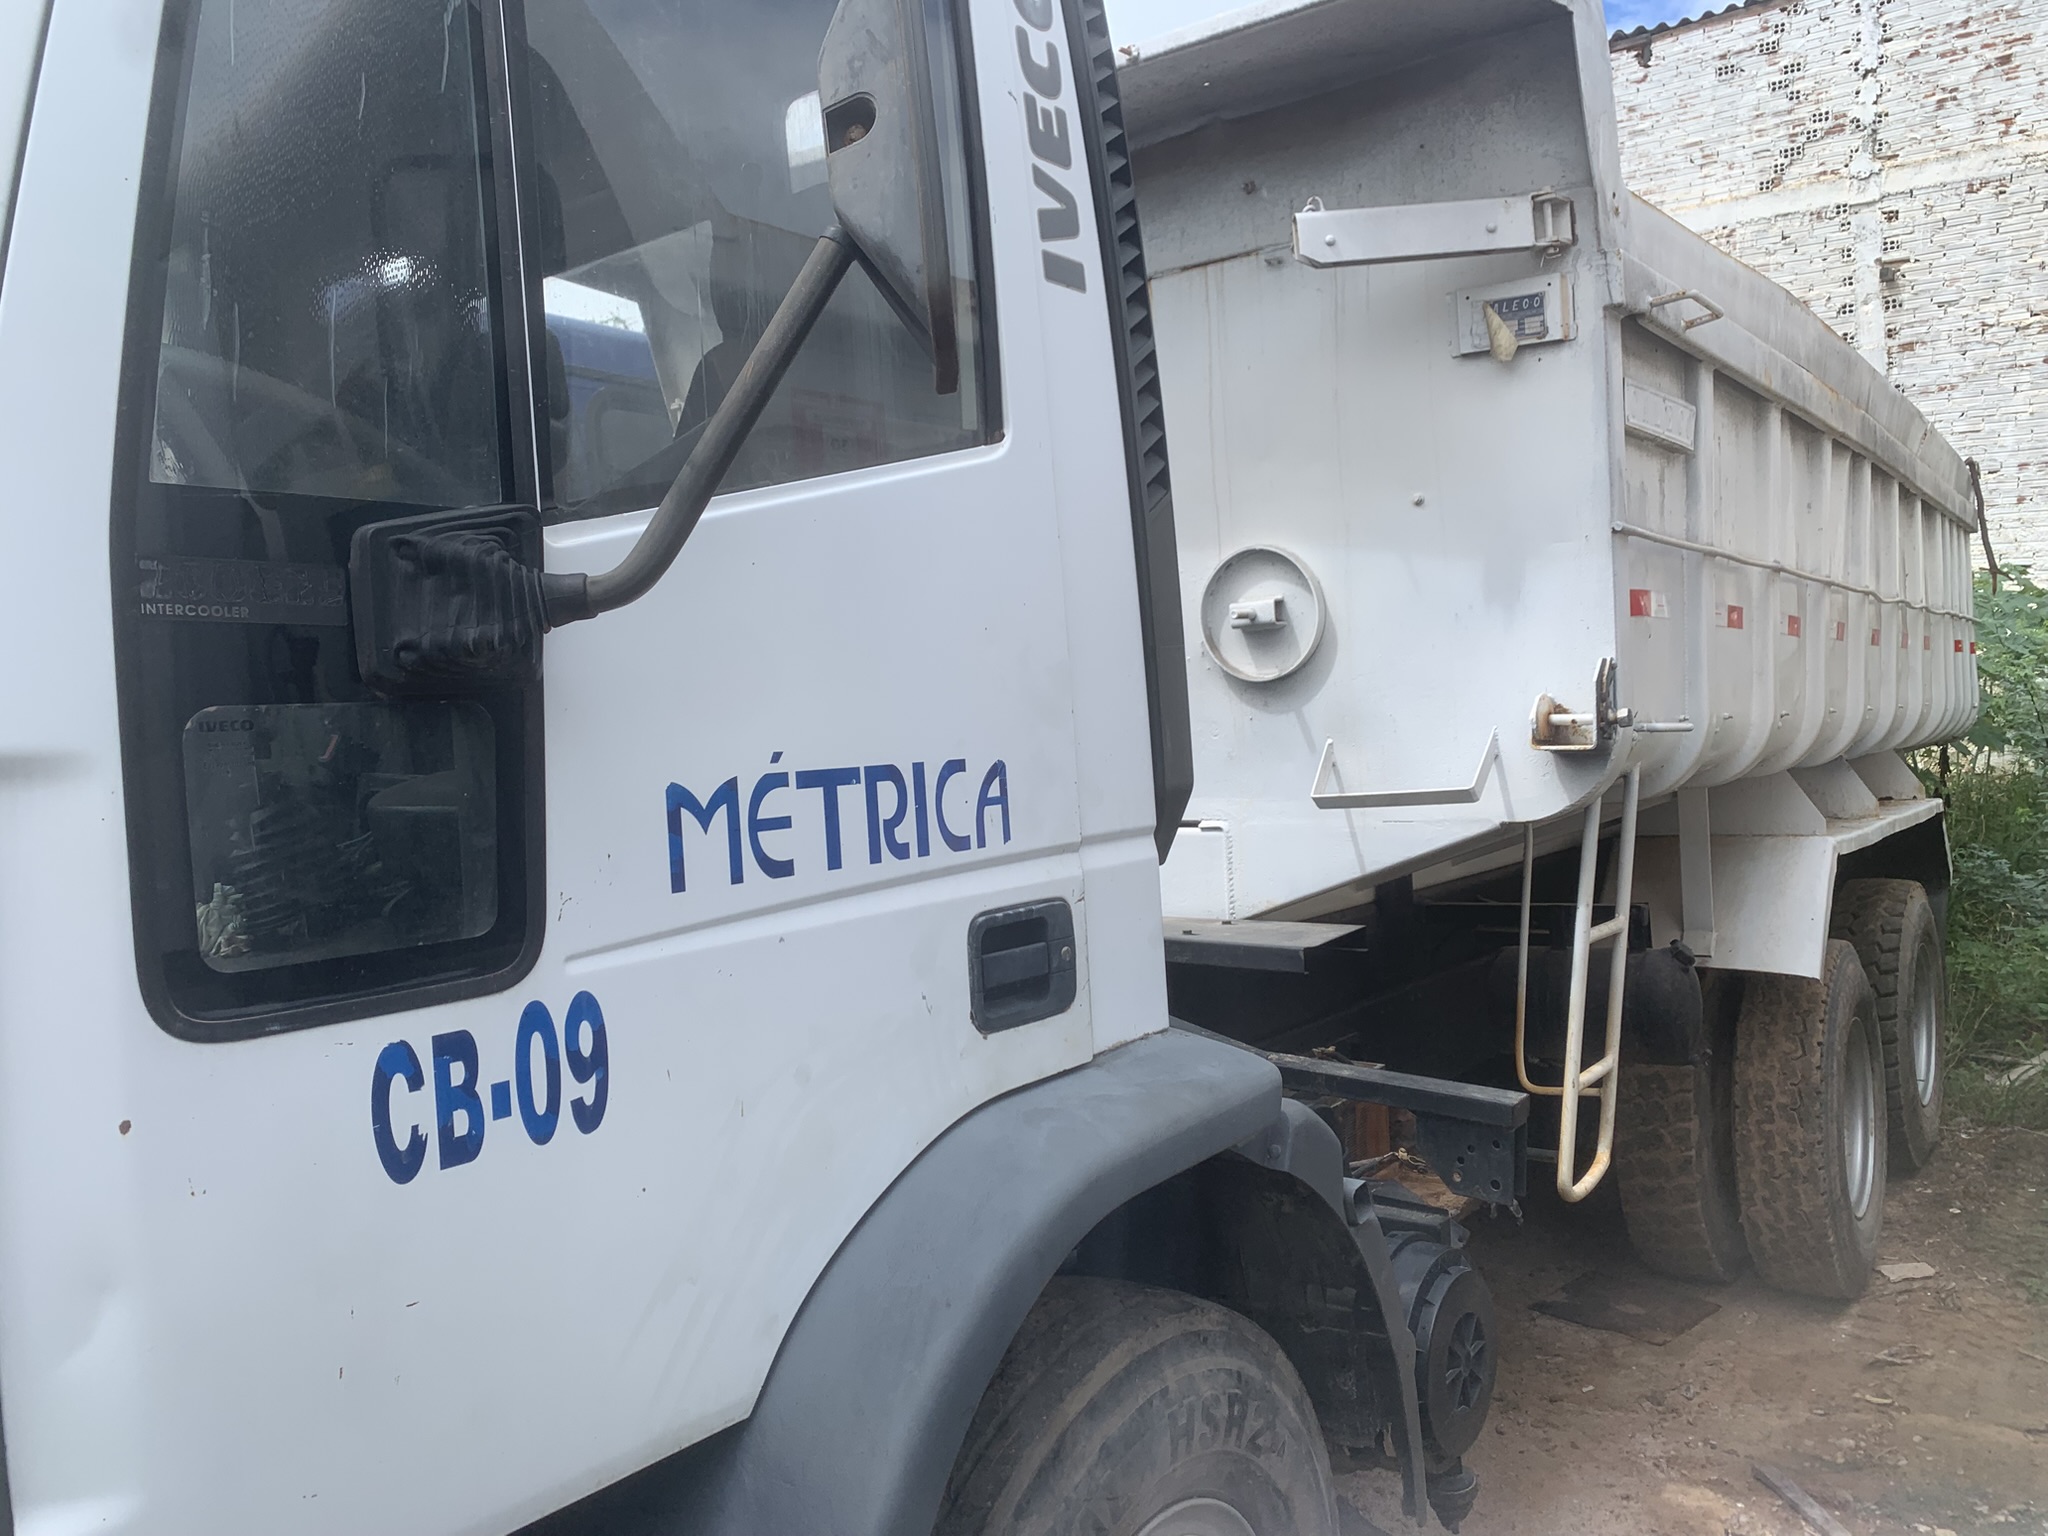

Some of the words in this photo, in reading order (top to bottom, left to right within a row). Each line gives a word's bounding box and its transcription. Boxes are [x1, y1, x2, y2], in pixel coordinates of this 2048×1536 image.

[140, 603, 250, 619] INTERCOOLER
[198, 719, 255, 733] IVECO
[665, 751, 1011, 893] MÉTRICA
[371, 990, 609, 1185] CB-09
